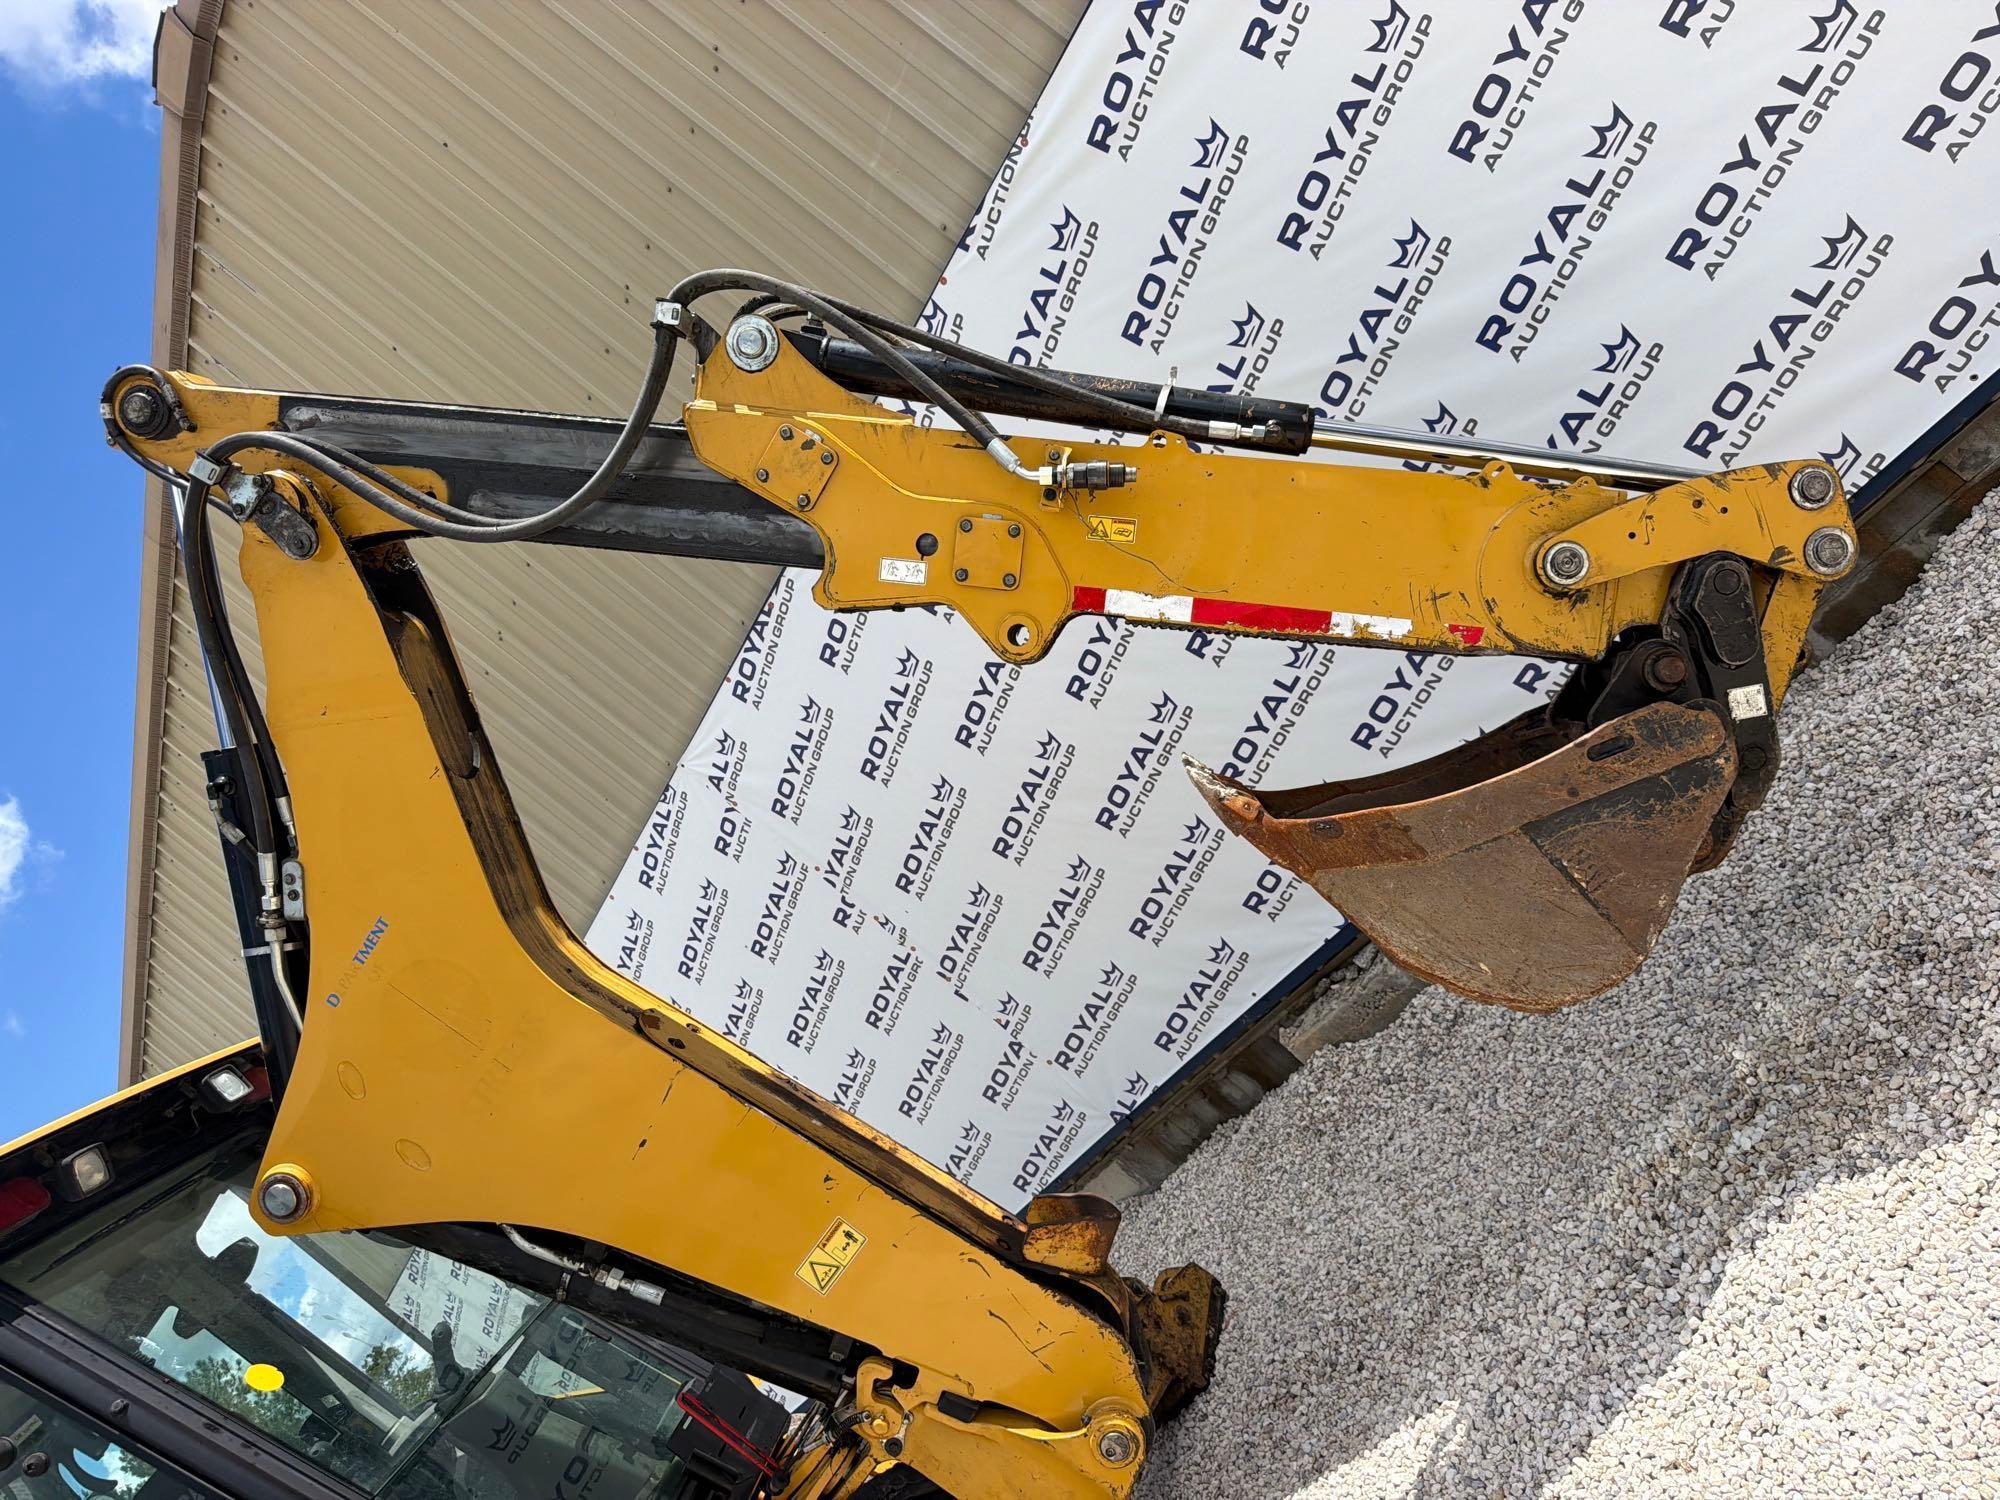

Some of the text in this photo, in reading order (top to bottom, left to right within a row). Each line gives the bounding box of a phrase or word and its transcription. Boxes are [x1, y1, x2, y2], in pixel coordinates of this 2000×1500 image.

[1086, 0, 1166, 153] ROYA
[1118, 30, 1175, 162] AUCTION
[1447, 0, 1558, 163] ROYA
[1484, 28, 1569, 173] AUCTION
[1902, 1, 2000, 153] ROY
[1277, 63, 1387, 252] ROYAL
[1310, 14, 1432, 261] AUCTION GROUP
[1665, 64, 1824, 271] ROYAL
[1704, 138, 1804, 281] AUCTION
[1798, 10, 1885, 134] GROUP
[977, 143, 1023, 261] AUCTION
[1150, 135, 1249, 355] AUCTION GROUP
[1510, 235, 1592, 363] AUCTION
[1586, 122, 1657, 232] GROUP
[1036, 221, 1099, 369] TION GROUP
[1121, 177, 1211, 346] ROYAL
[1475, 169, 1606, 353] ROYAL
[1008, 260, 1067, 367] OYAL
[1344, 236, 1451, 422] CTION GROUP
[1720, 234, 1894, 470] AUCTION GROUP
[1893, 249, 2000, 383] ROY
[1935, 302, 2000, 394] AUCT
[1596, 343, 1663, 437] GROUP
[1683, 280, 1835, 459] ROYAL
[752, 578, 794, 711] AUCTION GROUP
[841, 611, 867, 675] AUCTIO
[1090, 627, 1135, 710] AUCTION
[1290, 644, 1335, 716] GROUP
[860, 683, 910, 781] ROYAL
[881, 660, 933, 788] AUCTION GROUP
[955, 661, 1006, 749] ROYA
[977, 683, 1013, 757] AUCTION
[1350, 651, 1435, 750] ROYA
[1379, 673, 1442, 759] AUCTION
[728, 741, 747, 791] GROUP
[771, 728, 814, 819] ROYAL
[791, 708, 833, 825] AUCTION GROUP
[1014, 744, 1075, 867] AUCTION GROUP
[1095, 729, 1164, 831] ROYAL
[1119, 706, 1193, 839] AUCTION GROUP
[639, 809, 671, 889] ROYAL
[656, 791, 688, 896] AUCTION GROUP
[714, 805, 740, 856] ROY
[733, 817, 752, 863] AUCTI
[840, 866, 857, 896] TION
[851, 817, 873, 865] GROUP
[895, 807, 945, 894] ROYAL
[915, 788, 966, 901] AUCTION GROUP
[992, 765, 1050, 859] ROYAL
[823, 836, 852, 889] YAL
[1129, 849, 1197, 940] ROYAL
[1152, 828, 1225, 947] AUCTION GROUP
[1267, 877, 1302, 922] AUCTI
[617, 934, 639, 970] YAL
[639, 920, 654, 961] GROUP
[678, 905, 712, 979] ROYAL
[694, 889, 728, 986] AUCTION GROUP
[750, 880, 790, 959] ROYAL
[768, 910, 793, 965] AUCTION
[936, 912, 981, 979] OYAL
[954, 894, 1003, 989] UCTION GROUP
[1022, 886, 1081, 972] ROYAL
[1043, 868, 1105, 979] AUCTION GROUP
[723, 1003, 747, 1039] YAL
[746, 989, 763, 1030] GROUP
[787, 975, 828, 1048] ROYAL
[804, 960, 845, 1054] AUCTION GROUP
[865, 952, 911, 1030] ROYAL
[884, 982, 912, 1036] AUCTION
[1010, 1005, 1031, 1040] ROUP
[1054, 991, 1113, 1071] ROYAL
[1074, 974, 1137, 1078] AUCTION GROUP
[1154, 969, 1222, 1052] ROYAL
[1176, 952, 1249, 1061] AUCTION GROUP
[832, 1071, 858, 1107] YAL
[857, 1059, 877, 1100] GROUP
[898, 1047, 945, 1118] ROYAL
[916, 1034, 964, 1126] AUCTION GROUP
[982, 1041, 1025, 1104] ROYA
[1001, 1065, 1030, 1111] AUCTION
[945, 1144, 972, 1178] YAL
[968, 1132, 992, 1174] GROUP
[1013, 1125, 1064, 1193] ROYAL
[1063, 1111, 1087, 1153] GROUP
[408, 1248, 422, 1285] ROYA
[443, 1304, 454, 1324] YAL
[482, 1297, 500, 1338] ROYAL
